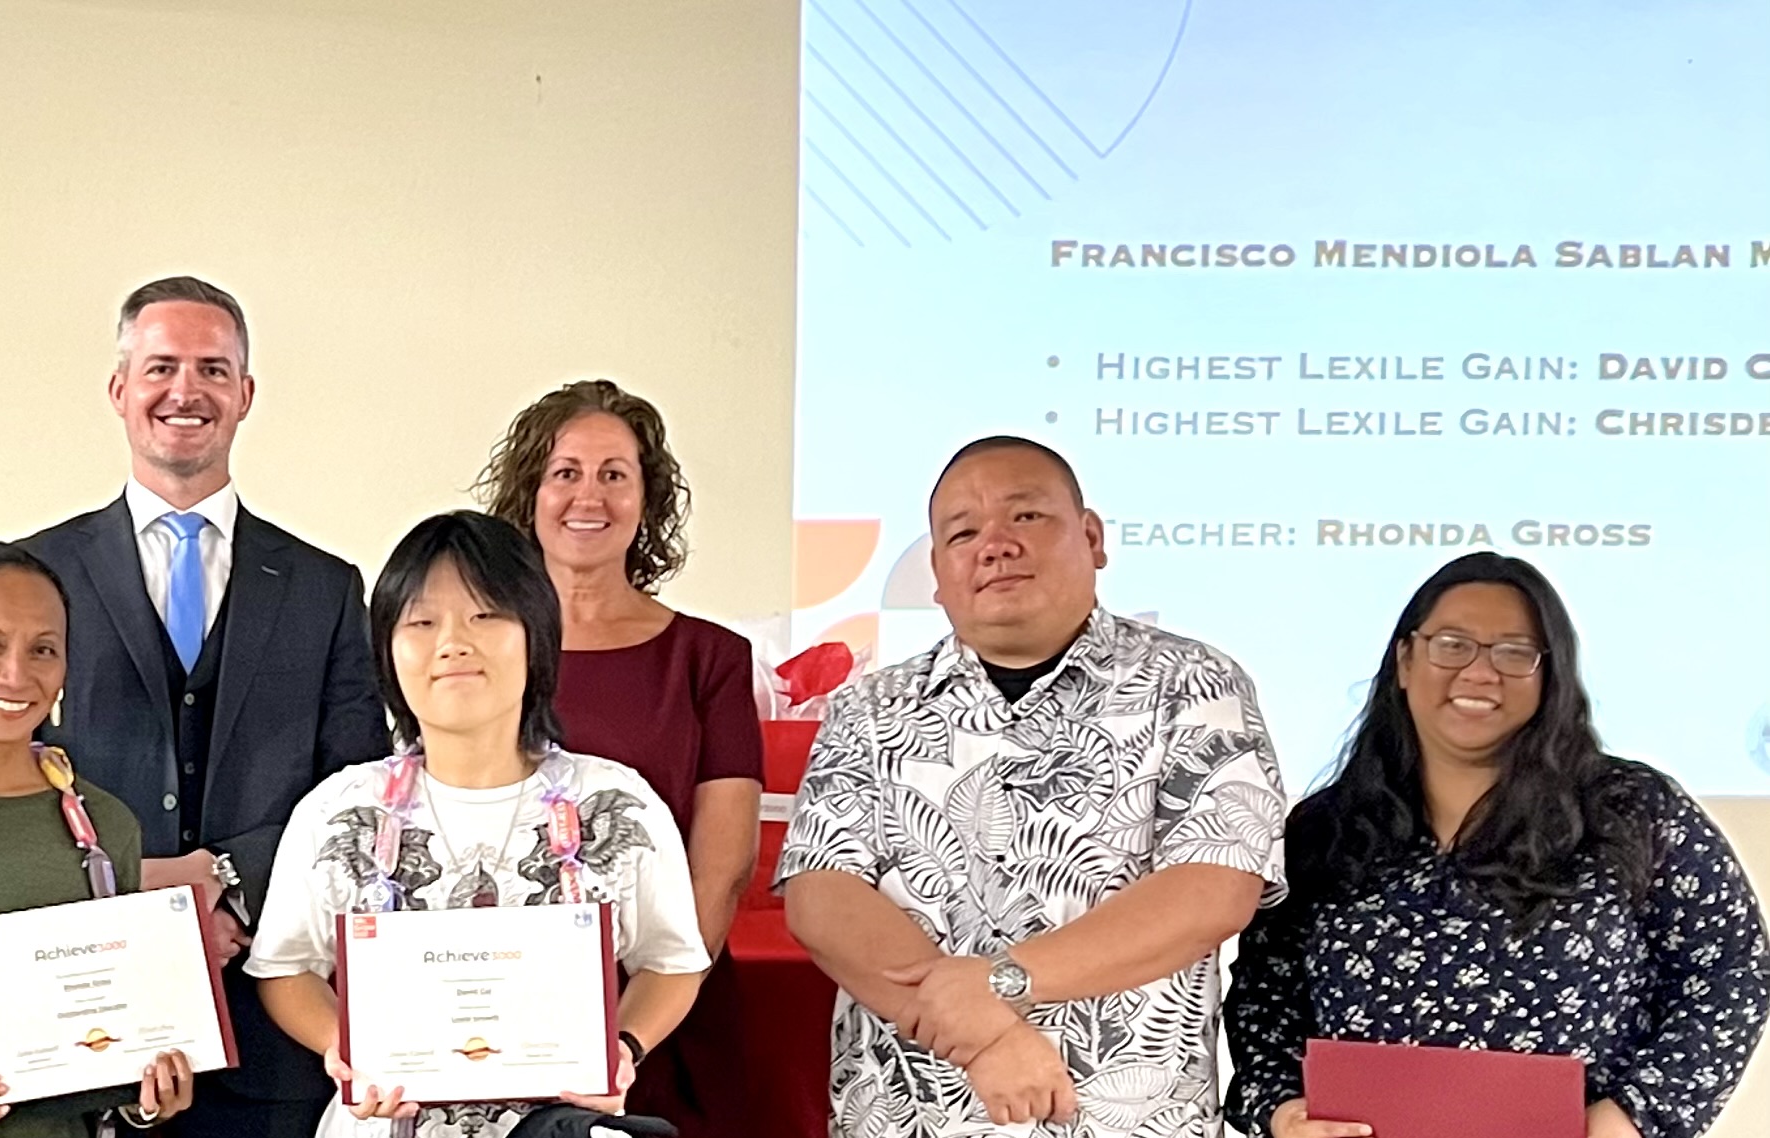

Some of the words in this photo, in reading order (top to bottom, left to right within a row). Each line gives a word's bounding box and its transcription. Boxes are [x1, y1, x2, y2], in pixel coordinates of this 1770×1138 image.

[1050, 239, 1296, 269] FRANCISCO
[1313, 239, 1538, 269] MENDIOLA
[1554, 239, 1731, 269] SABLAN
[1096, 352, 1283, 381] HIGHEST
[1298, 352, 1445, 381] LEXILE
[1461, 352, 1578, 381] GAIN:
[1598, 352, 1729, 381] DAVID
[1095, 408, 1282, 436] HIGHEST
[1297, 408, 1444, 436] LEXILE
[1459, 408, 1577, 436] GAIN:
[1105, 518, 1296, 547] EACHER:
[1316, 518, 1494, 547] RHONDA
[1511, 518, 1653, 547] GROSS
